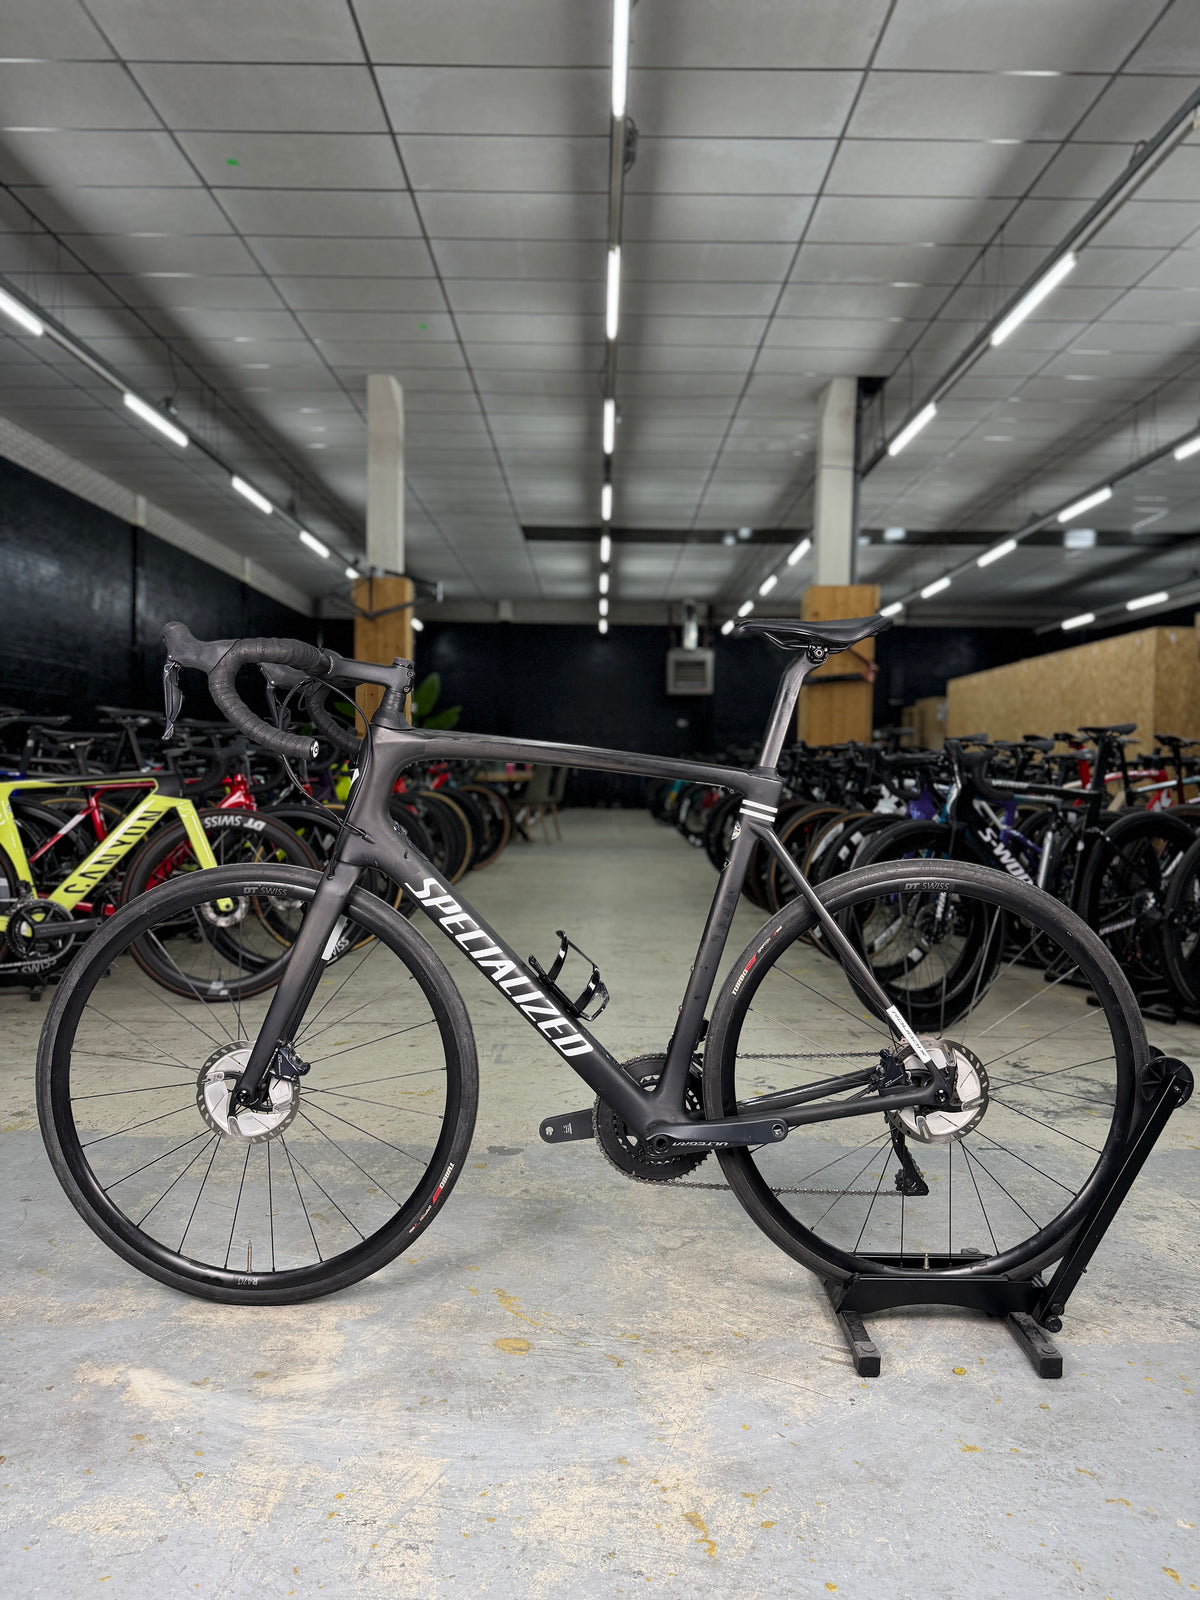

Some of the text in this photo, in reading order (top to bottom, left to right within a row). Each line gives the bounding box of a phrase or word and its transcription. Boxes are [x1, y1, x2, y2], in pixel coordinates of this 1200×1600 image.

[204, 815, 266, 832] DT SWISS
[63, 811, 163, 894] CANYON
[260, 887, 288, 896] SWISS
[904, 881, 950, 890] DT SWISS
[404, 877, 594, 1057] SPECIALIZED
[731, 968, 749, 996] TURBO
[439, 1162, 456, 1189] TURBO
